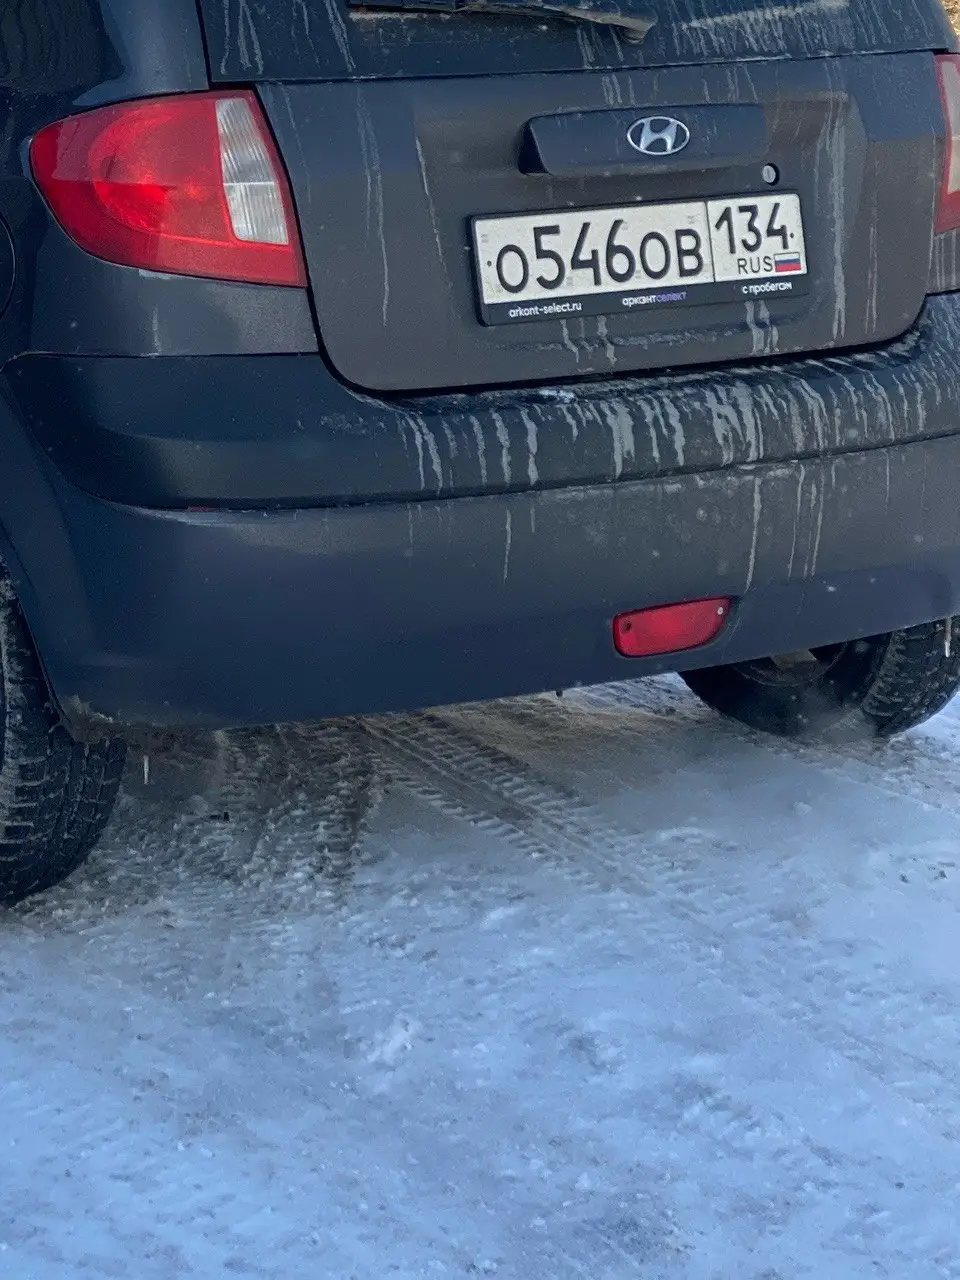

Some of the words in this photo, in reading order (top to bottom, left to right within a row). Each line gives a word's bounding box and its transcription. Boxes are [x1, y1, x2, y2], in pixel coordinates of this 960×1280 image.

[714, 202, 789, 255] 134
[737, 256, 773, 276] RUS
[509, 302, 582, 318] arkont-select.ru
